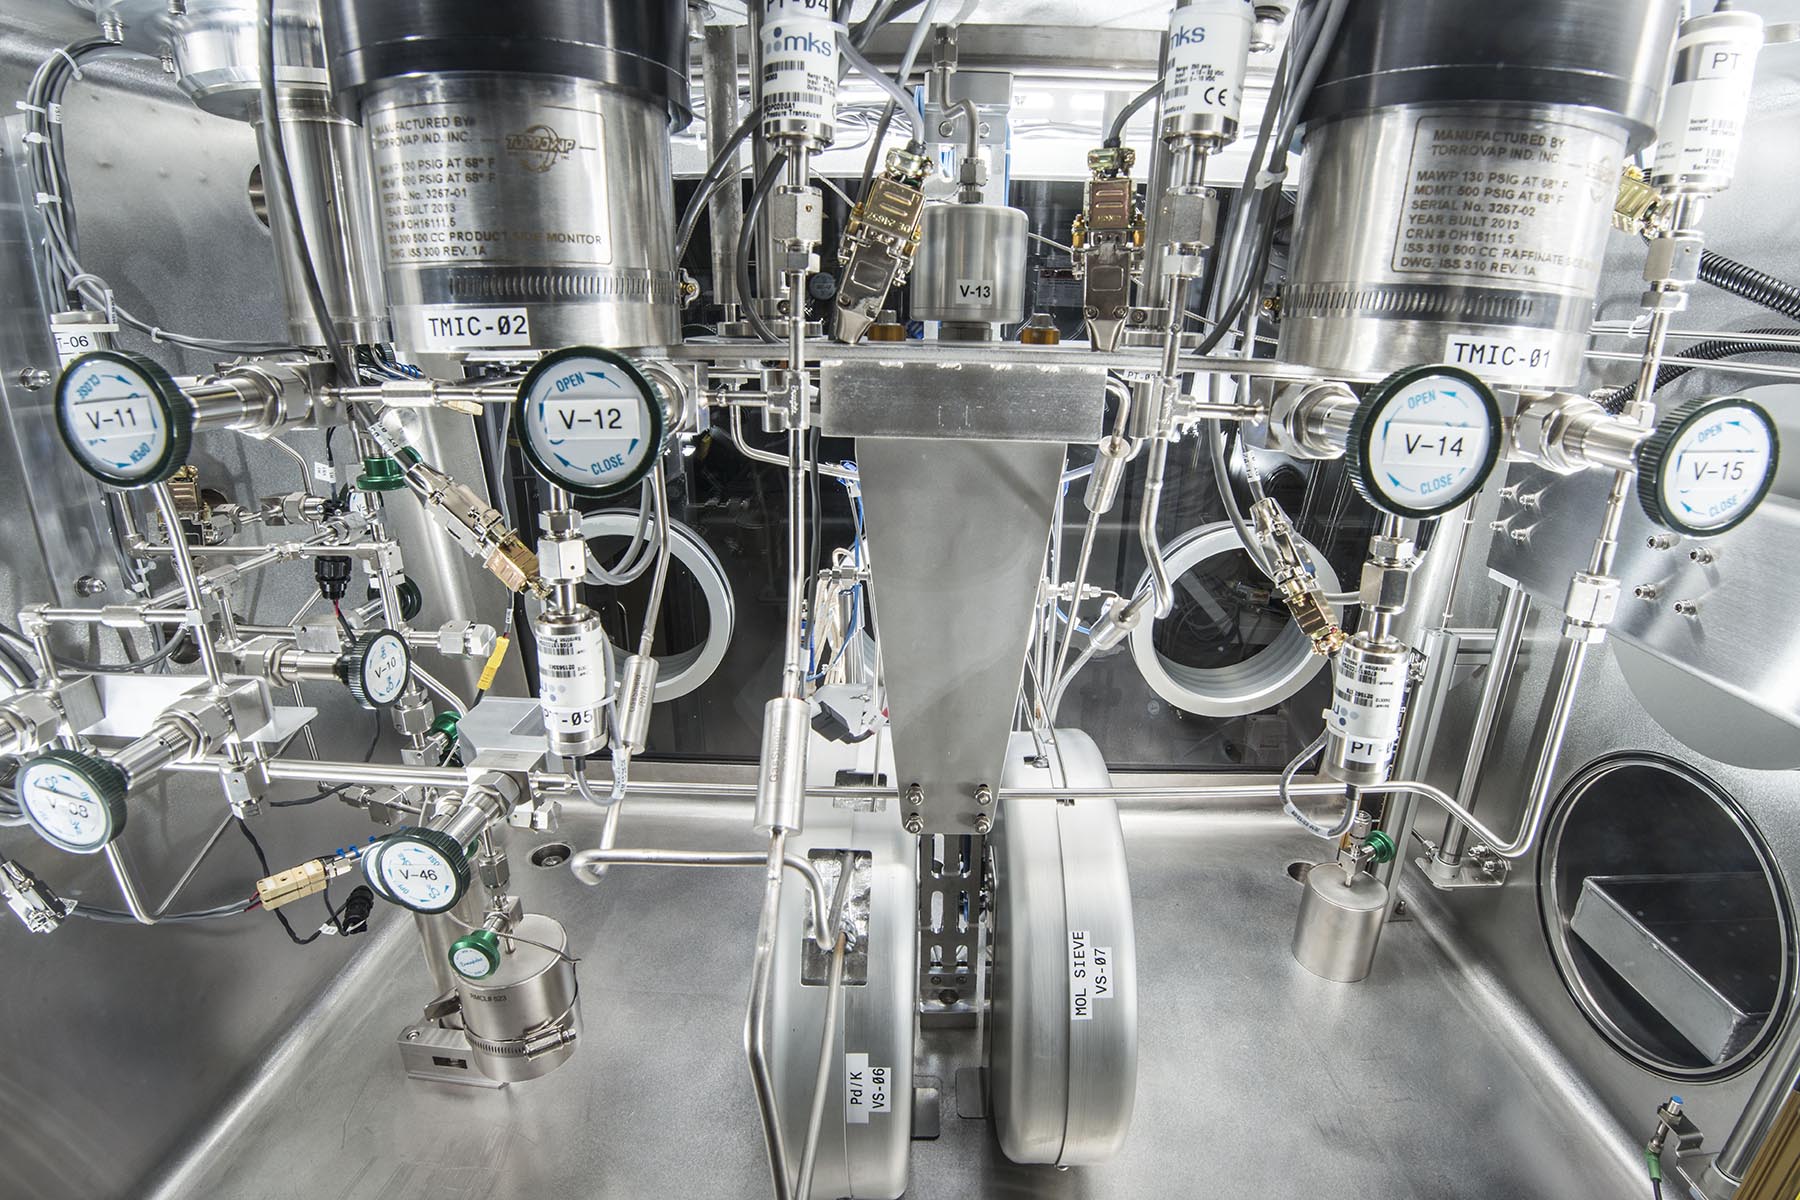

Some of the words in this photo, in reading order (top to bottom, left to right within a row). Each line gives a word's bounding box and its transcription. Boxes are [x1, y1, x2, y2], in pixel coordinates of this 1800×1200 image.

[784, 32, 832, 57] mks
[1433, 129, 1546, 147] MANUFACTURED
[1550, 137, 1566, 149] BY
[1431, 144, 1507, 158] TORROVAP
[418, 159, 444, 170] PSIG
[446, 158, 462, 168] AT
[419, 174, 445, 185] PSIG
[447, 173, 462, 183] AT
[1416, 170, 1459, 182] MAWP
[1462, 171, 1484, 182] 130
[1487, 172, 1519, 185] PSIG
[1522, 176, 1538, 187] AT
[425, 187, 467, 199] 3267-01
[1483, 187, 1515, 200] PSIG
[1518, 191, 1535, 202] AT
[404, 204, 428, 216] BUILT
[431, 203, 456, 214] 2013
[1411, 199, 1458, 211] SERIAL
[1463, 201, 1485, 213] No.
[1488, 203, 1536, 217] 3267-02
[1408, 214, 1445, 226] YEAR
[1448, 215, 1488, 228] BUILT
[1490, 218, 1520, 230] 2013
[430, 231, 445, 242] CC
[449, 231, 507, 242] PRODUCT
[546, 232, 602, 245] MONITOR
[1405, 228, 1434, 240] CRN
[443, 245, 469, 257] REV.
[471, 245, 487, 256] 1A
[1403, 242, 1424, 253] ISS
[1427, 243, 1450, 255] 310
[1479, 246, 1498, 258] CC
[1502, 248, 1566, 265] RAFFINATE
[1400, 256, 1434, 268] DWG.
[1464, 260, 1487, 272] 310
[1489, 262, 1518, 275] REV.
[1523, 265, 1537, 277] 1A
[959, 284, 991, 299] V-13
[427, 314, 528, 338] TMIC-02
[56, 335, 89, 348] T-06
[1454, 342, 1551, 369] TMIC-01
[555, 371, 586, 393] OPEN
[1407, 390, 1437, 409] OPEN
[85, 407, 137, 430] V-11
[558, 408, 623, 430] V-12
[1697, 423, 1724, 443] OPEN
[1405, 433, 1465, 457] V-14
[590, 453, 625, 476] CLOSE
[1693, 461, 1745, 481] V-15
[1419, 473, 1454, 495] CLOSE
[1708, 495, 1739, 517] CLOSE
[374, 656, 397, 679] V-10
[399, 869, 438, 881] V-46
[1072, 931, 1087, 978] SIEVE
[1093, 948, 1108, 995] VS-07
[1074, 987, 1088, 1016] MOL
[849, 1071, 864, 1106] Pd/K
[871, 1068, 886, 1109] VS-06
